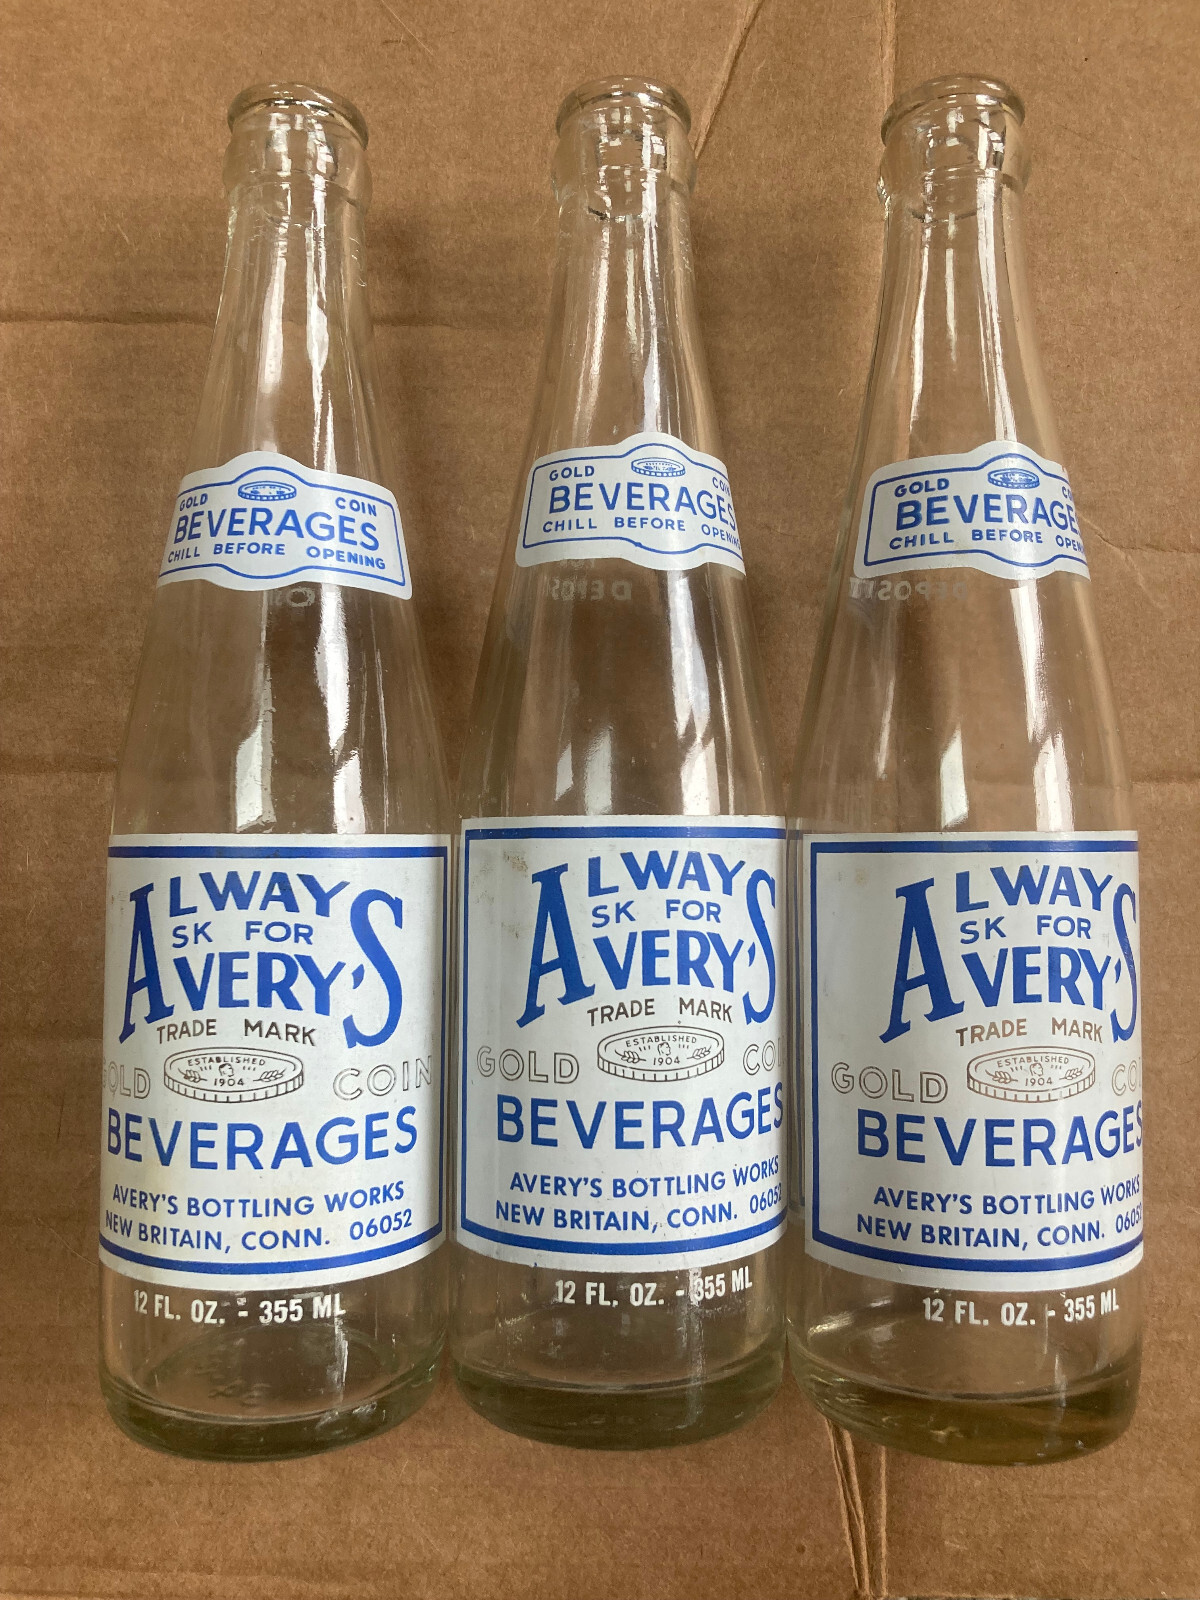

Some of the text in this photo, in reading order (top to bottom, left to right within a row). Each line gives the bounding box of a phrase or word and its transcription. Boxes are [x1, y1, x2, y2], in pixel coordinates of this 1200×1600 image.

[550, 465, 594, 481] GOLD
[894, 478, 950, 498] GOLD
[180, 493, 376, 517] GOLD COIN
[549, 482, 736, 531] BEVERAGES
[896, 493, 1081, 537] BEVERAGE
[174, 507, 379, 551] BEVERAGES
[543, 518, 597, 533] CHILL
[614, 517, 685, 532] BEFORE
[889, 532, 954, 550] CHILL
[972, 529, 1043, 544] BEFORE
[168, 542, 386, 570] CHILL BEFORE OPENING
[666, 899, 722, 923] FOR
[1037, 914, 1091, 940] FOR
[246, 920, 314, 946] FOR
[586, 997, 733, 1027] TRADE MARK
[157, 1018, 317, 1046] TRADE MARK
[625, 1035, 698, 1048] ESTABLISHED
[955, 1018, 1103, 1047] TRADE MARK
[103, 1054, 432, 1100] OLD COIN
[187, 1055, 266, 1067] ESTABLISHED
[476, 1045, 579, 1084] GOLD
[652, 1056, 681, 1066] 1904
[997, 1055, 1070, 1068] ESTABLISHED
[214, 1077, 245, 1087] 1904
[831, 1062, 948, 1104] GOLD
[1024, 1076, 1053, 1086] 1904
[497, 1081, 784, 1150] BEVERAGES
[107, 1105, 417, 1170] BEVERAGES
[857, 1099, 1142, 1167] BEVERAGES
[509, 1154, 779, 1199] AVERY'S BOTTLING WORKS
[112, 1180, 405, 1218] AVERY'S BOTTLING WORKS
[873, 1174, 1140, 1215] AVERY'S BOTTLING WORKS
[105, 1208, 412, 1254] NEW BRITAIN, CONN. 06052
[495, 1200, 545, 1225] NEW
[554, 1208, 659, 1234] BRITAIN,
[667, 1201, 738, 1228] CONN.
[857, 1214, 911, 1240] NEW
[921, 1224, 1027, 1251] BRITAIN,
[1037, 1220, 1105, 1248] CONN.
[555, 1280, 576, 1304] 12
[586, 1282, 618, 1307] FL.
[630, 1283, 665, 1307] OZ.
[694, 1273, 726, 1300] 355
[732, 1265, 753, 1292] ML
[134, 1290, 148, 1314] 12
[154, 1295, 181, 1320] FL.
[190, 1300, 225, 1324] OZ.
[259, 1299, 303, 1324] 355
[312, 1293, 347, 1319] ML
[922, 1298, 944, 1322] 12
[955, 1300, 989, 1325] FL.
[1000, 1302, 1035, 1326] OZ.
[1064, 1296, 1095, 1322] 355
[1100, 1288, 1119, 1315] ML
